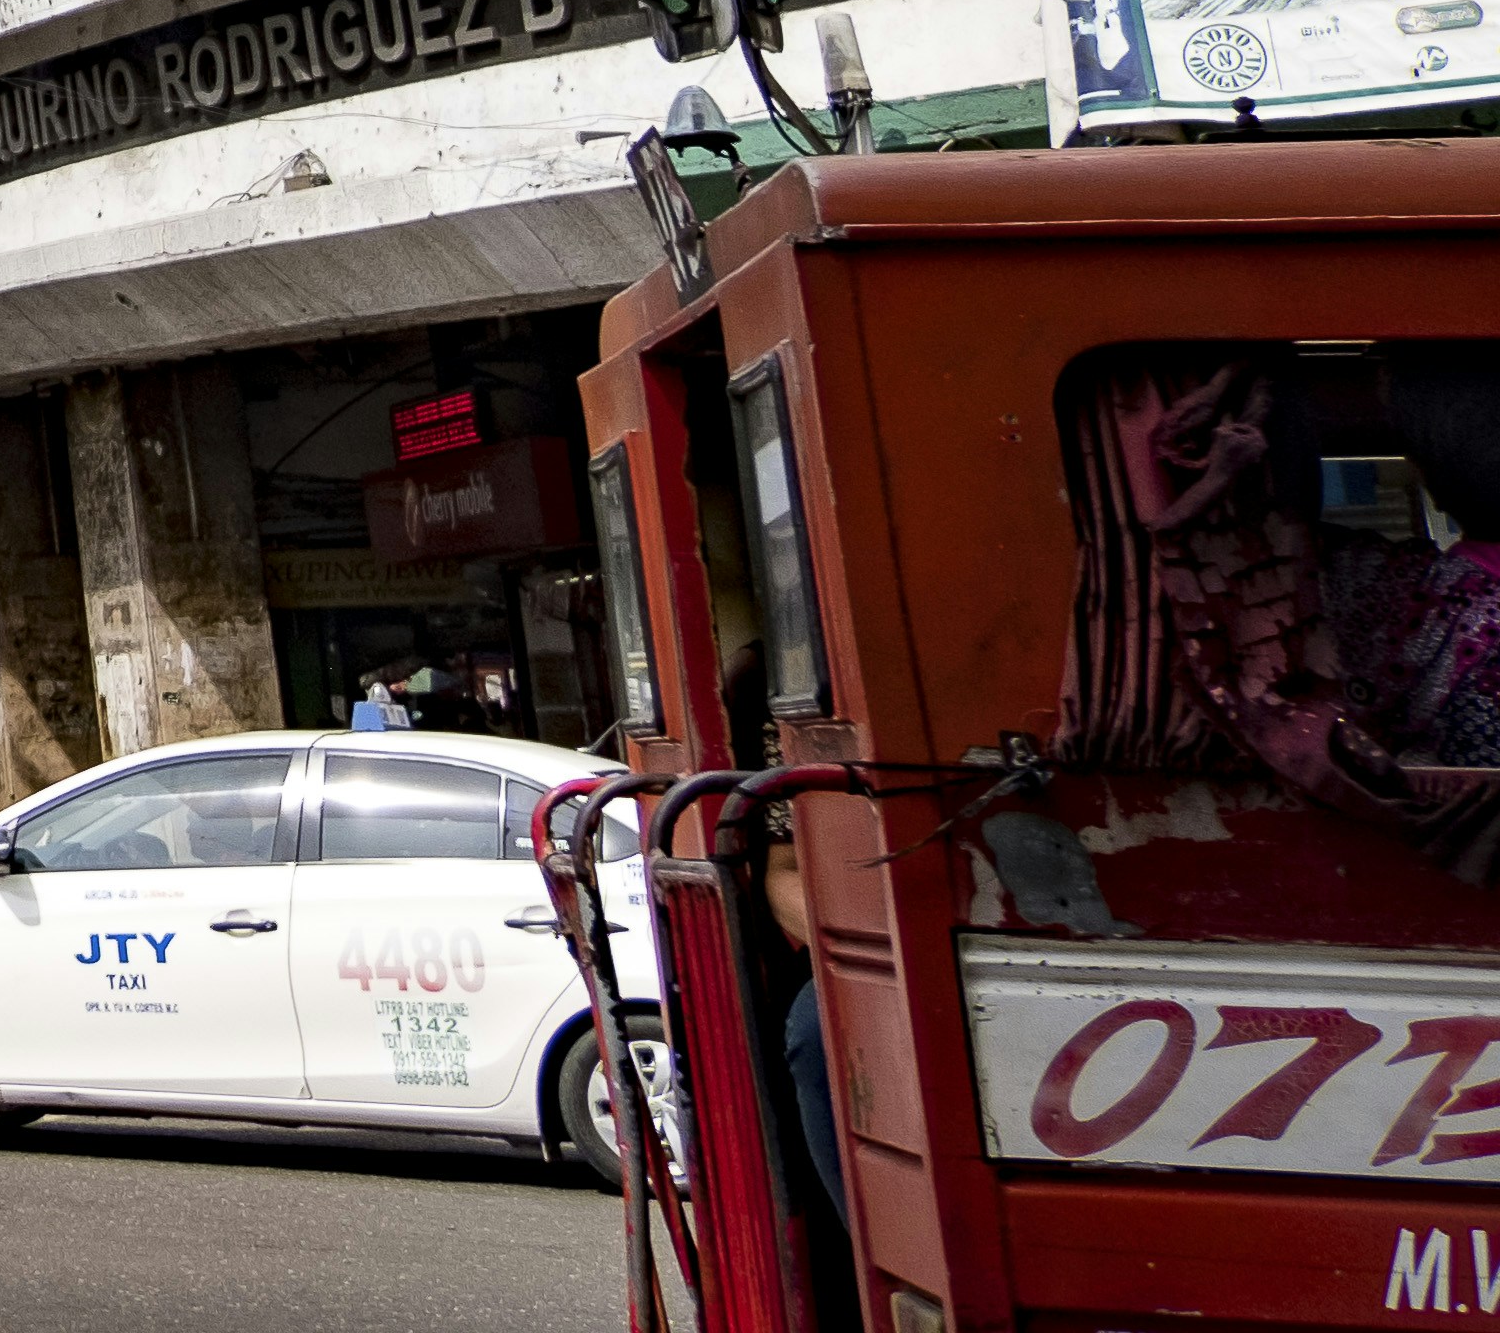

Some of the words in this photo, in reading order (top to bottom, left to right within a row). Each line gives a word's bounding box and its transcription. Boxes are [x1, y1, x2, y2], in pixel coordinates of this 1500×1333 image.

[421, 483, 456, 530] cherry
[455, 471, 494, 517] mobile
[73, 932, 177, 964] JTY
[338, 926, 487, 993] 4480
[105, 973, 148, 991] TAXI
